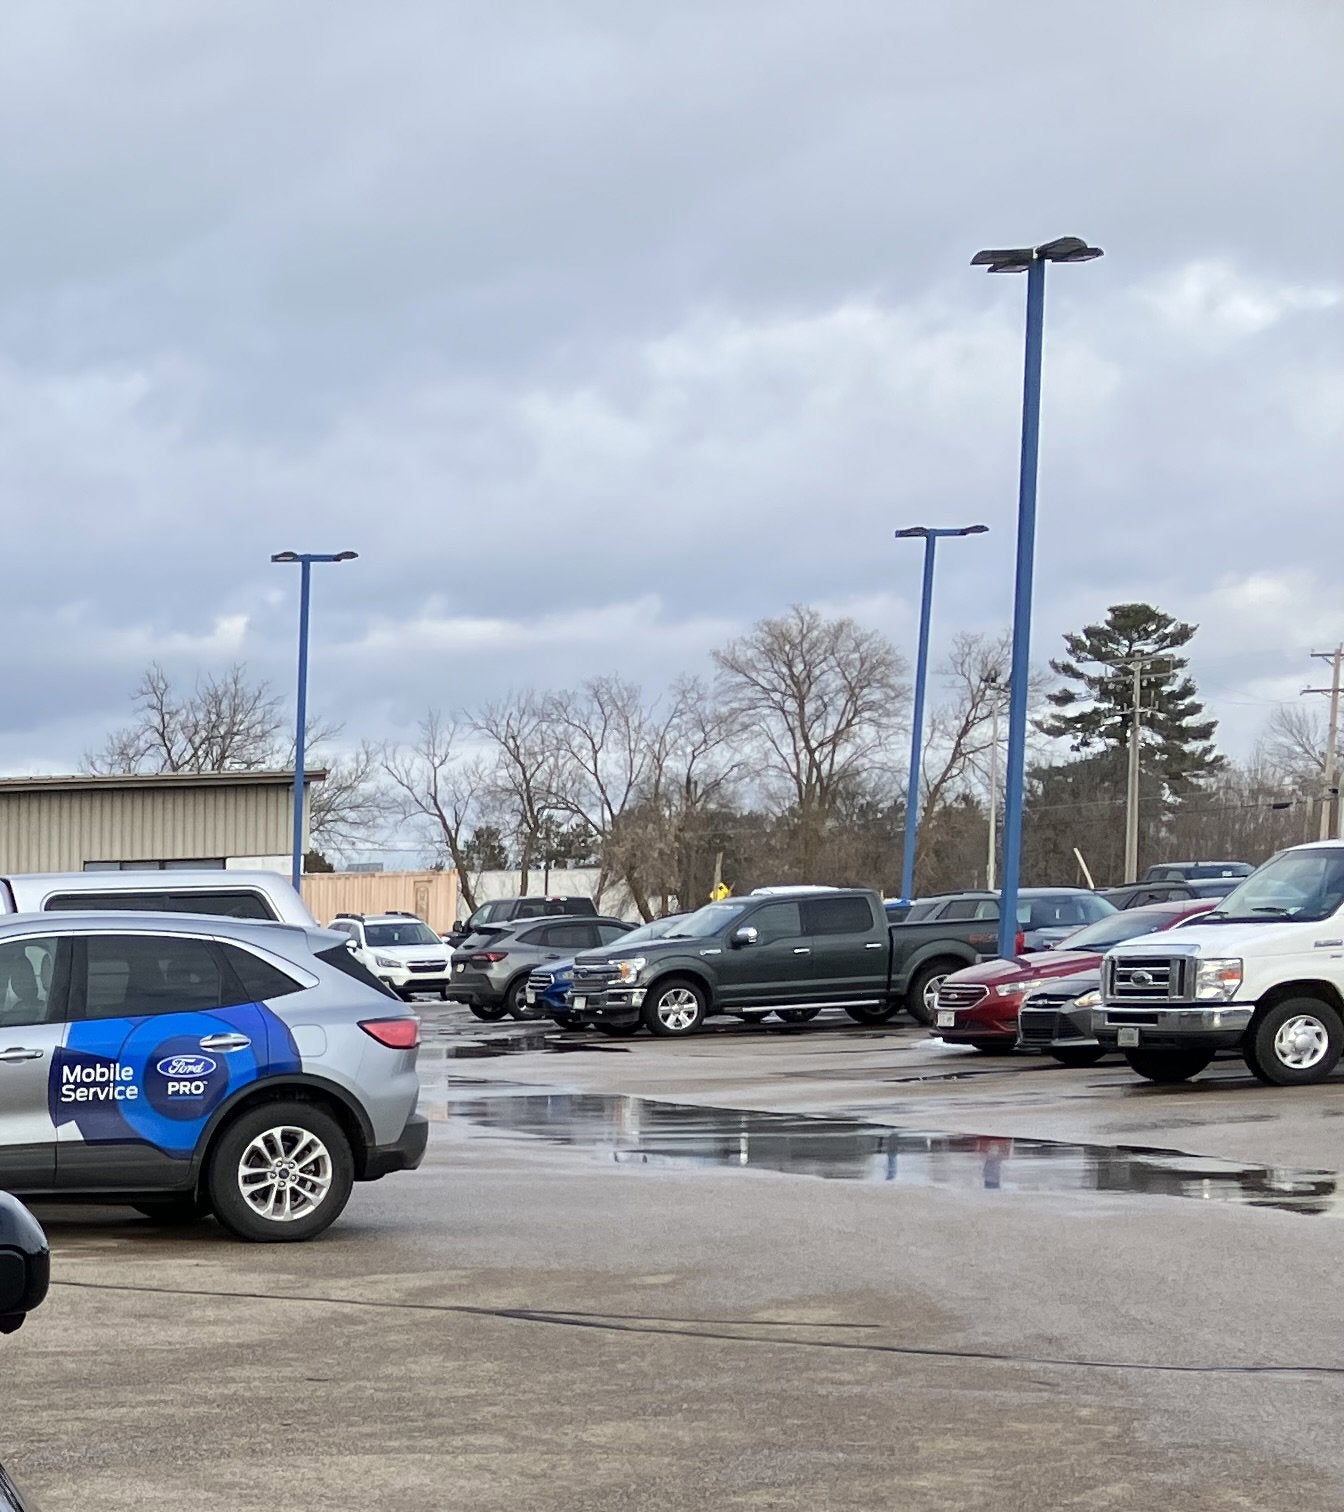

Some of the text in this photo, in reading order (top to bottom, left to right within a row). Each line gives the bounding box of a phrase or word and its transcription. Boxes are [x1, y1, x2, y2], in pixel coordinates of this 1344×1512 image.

[62, 1063, 134, 1083] Mobile
[167, 1058, 205, 1075] Ford
[60, 1083, 139, 1103] Service
